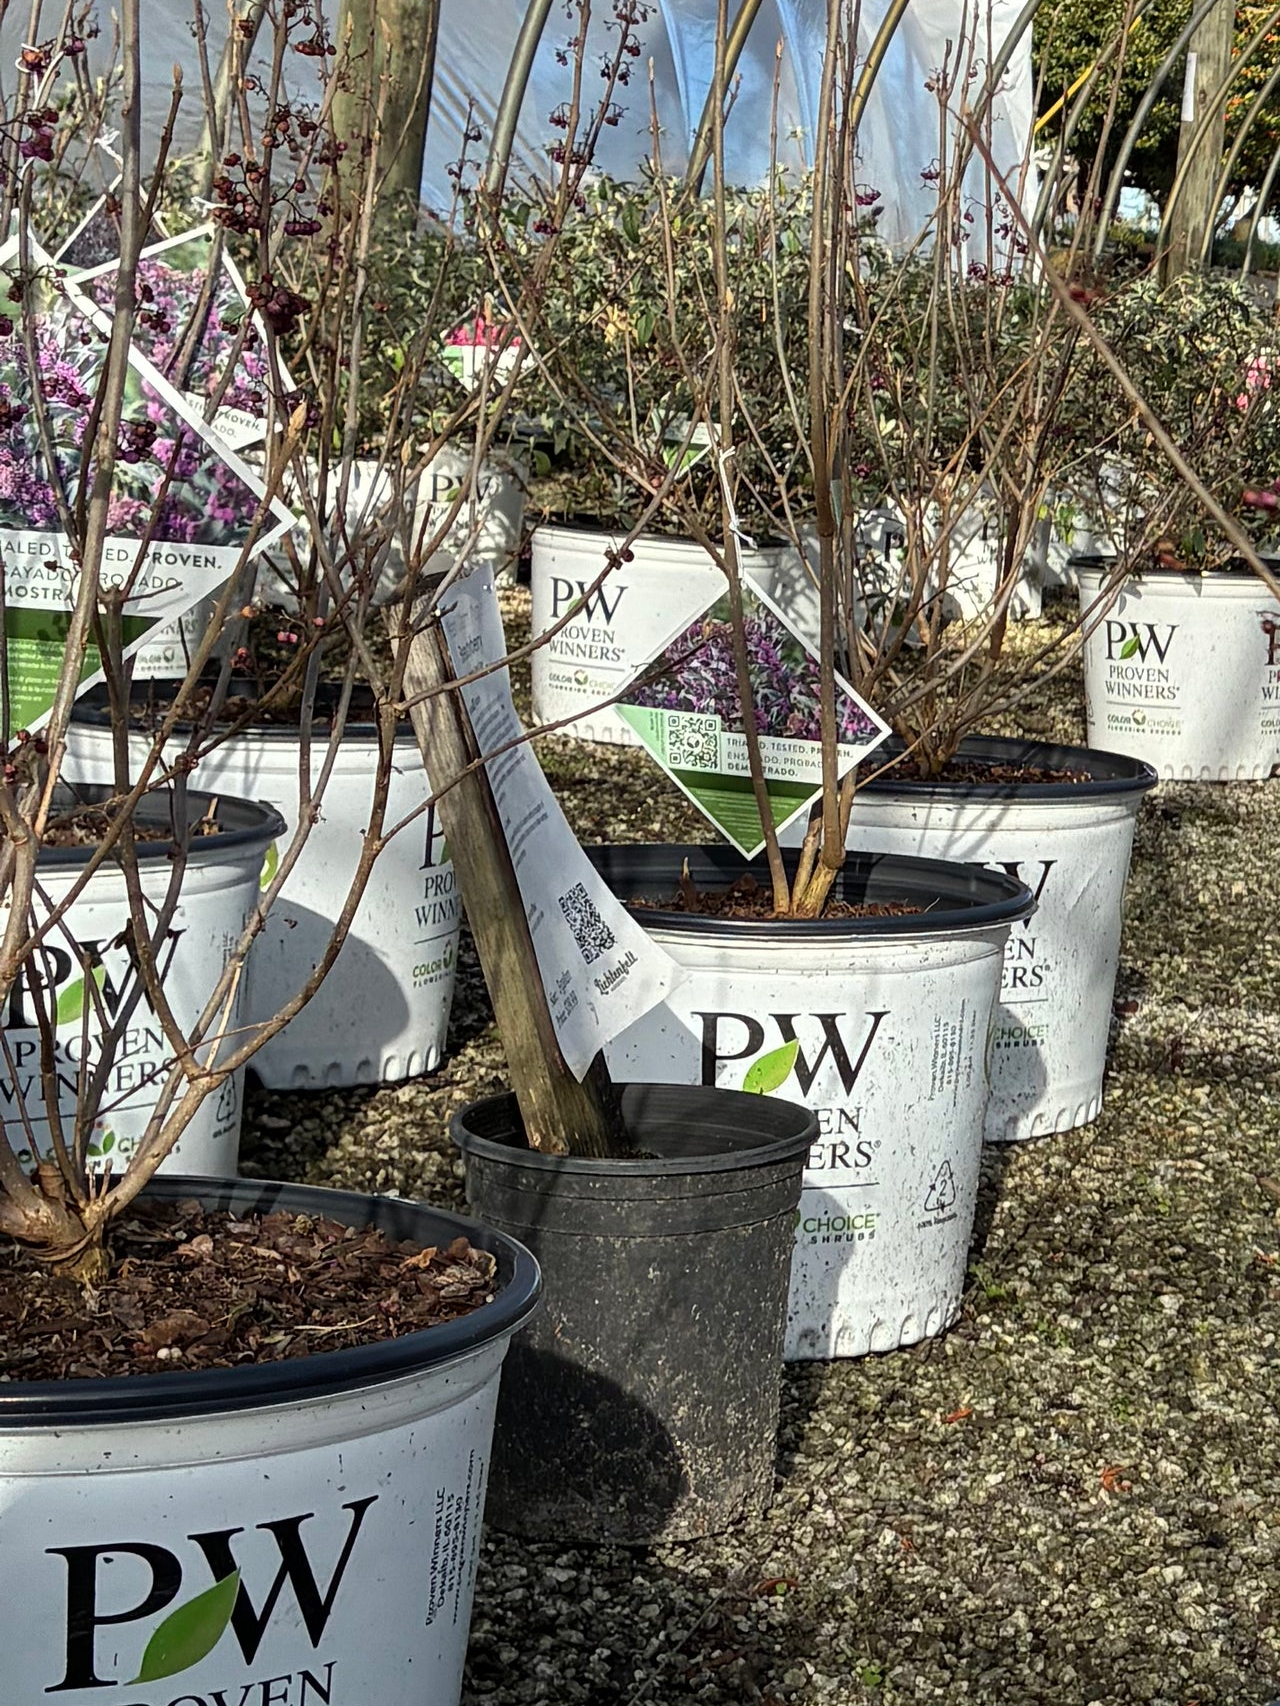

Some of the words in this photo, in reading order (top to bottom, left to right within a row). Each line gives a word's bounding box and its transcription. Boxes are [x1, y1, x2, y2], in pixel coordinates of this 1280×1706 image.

[63, 544, 133, 562] TED.
[550, 576, 628, 626] PW
[560, 625, 615, 644] ROVEN
[1104, 620, 1179, 664] PW
[1109, 665, 1169, 684] PROVEN
[783, 757, 823, 769] PROBAD
[424, 871, 457, 899] PRO
[414, 897, 459, 928] WINN
[412, 963, 442, 978] COLOR
[690, 1010, 891, 1099] PW
[803, 1213, 876, 1234] CHOICE
[810, 1230, 876, 1245] SHRUBS
[436, 1487, 445, 1515] LLC
[430, 1516, 443, 1575] Winners
[45, 1494, 379, 1693] PW
[426, 1573, 440, 1626] Proven
